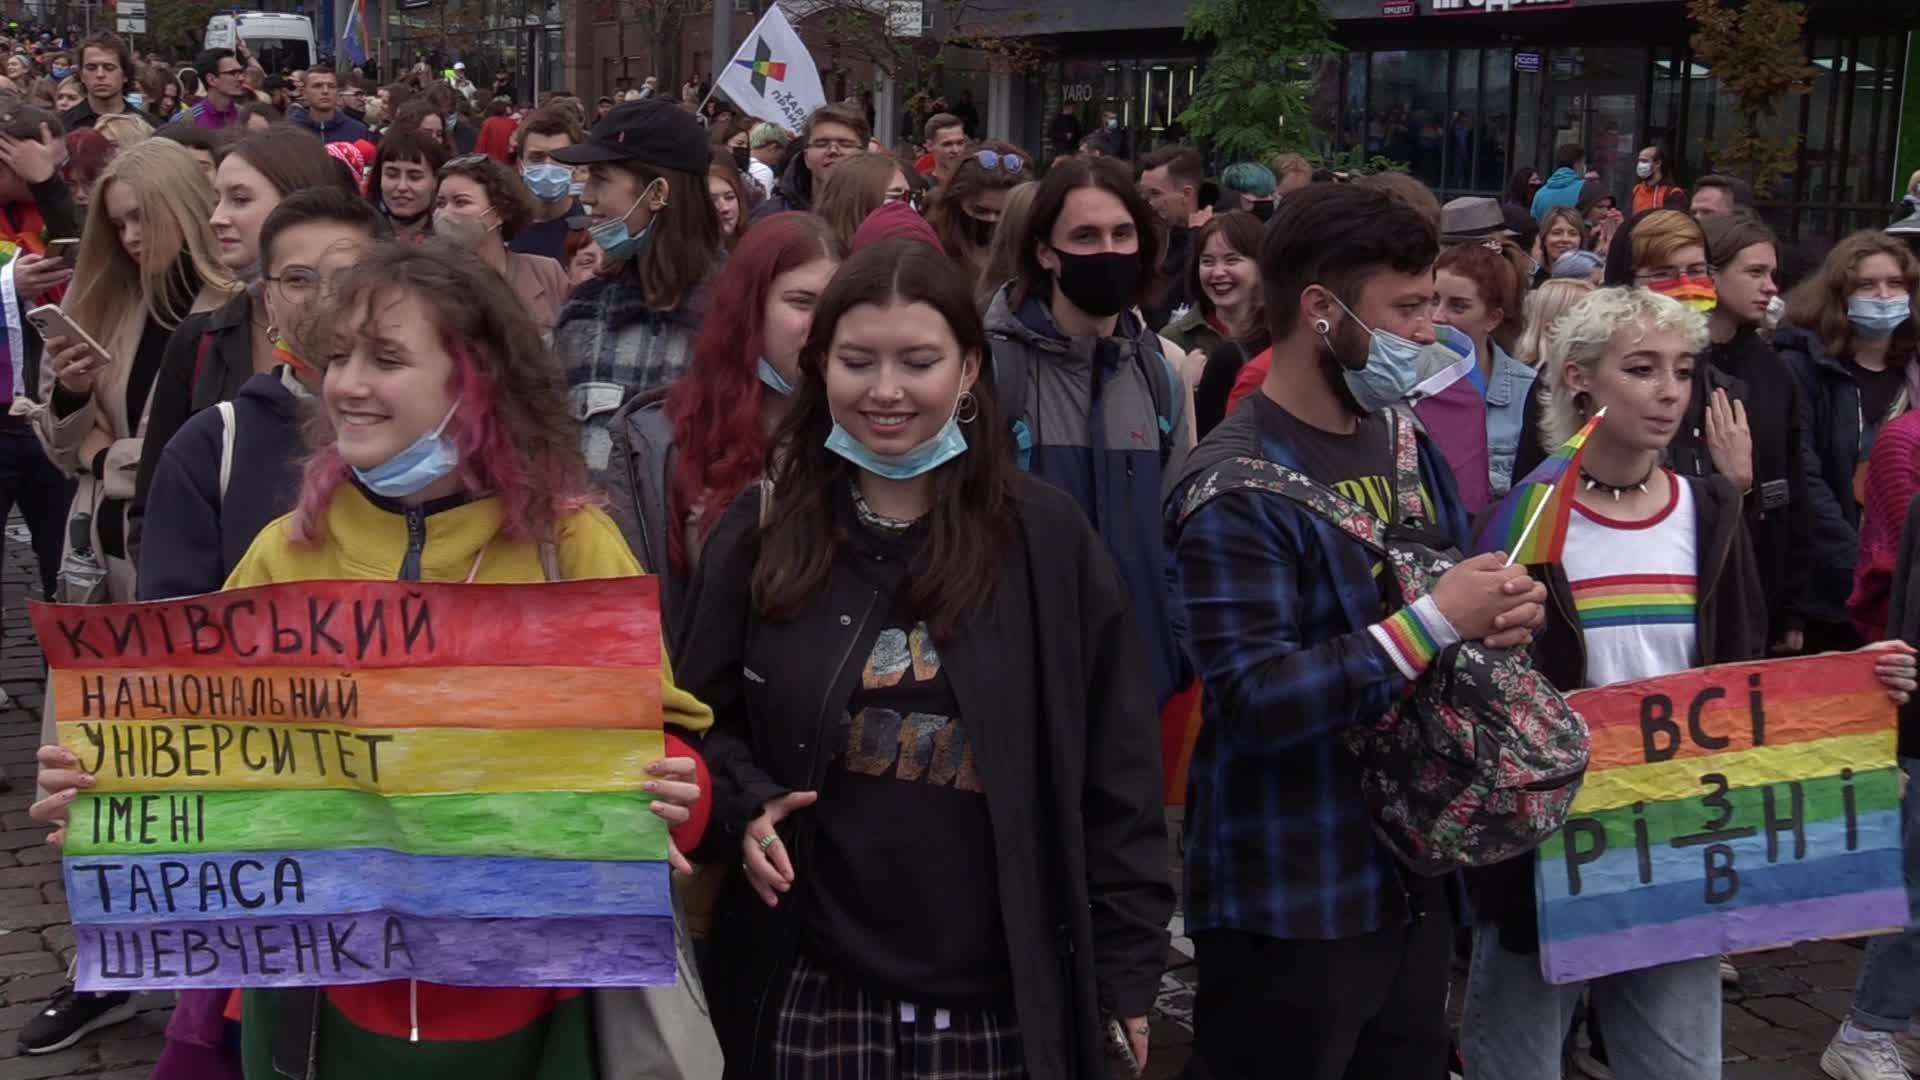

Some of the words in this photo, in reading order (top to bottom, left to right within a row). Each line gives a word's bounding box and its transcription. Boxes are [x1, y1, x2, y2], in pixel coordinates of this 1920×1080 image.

[1062, 84, 1093, 101] YARO
[57, 592, 435, 660] КИЇВСЬКИЙ
[80, 672, 359, 719] НАЦІОНАЛЬНИЙ
[77, 722, 395, 783] УНІВЕРСИТЕТ
[92, 795, 205, 844] ІМЕНІ
[73, 857, 305, 913] ТАРАСА
[100, 915, 416, 978] ШЕВЧЕНКА
